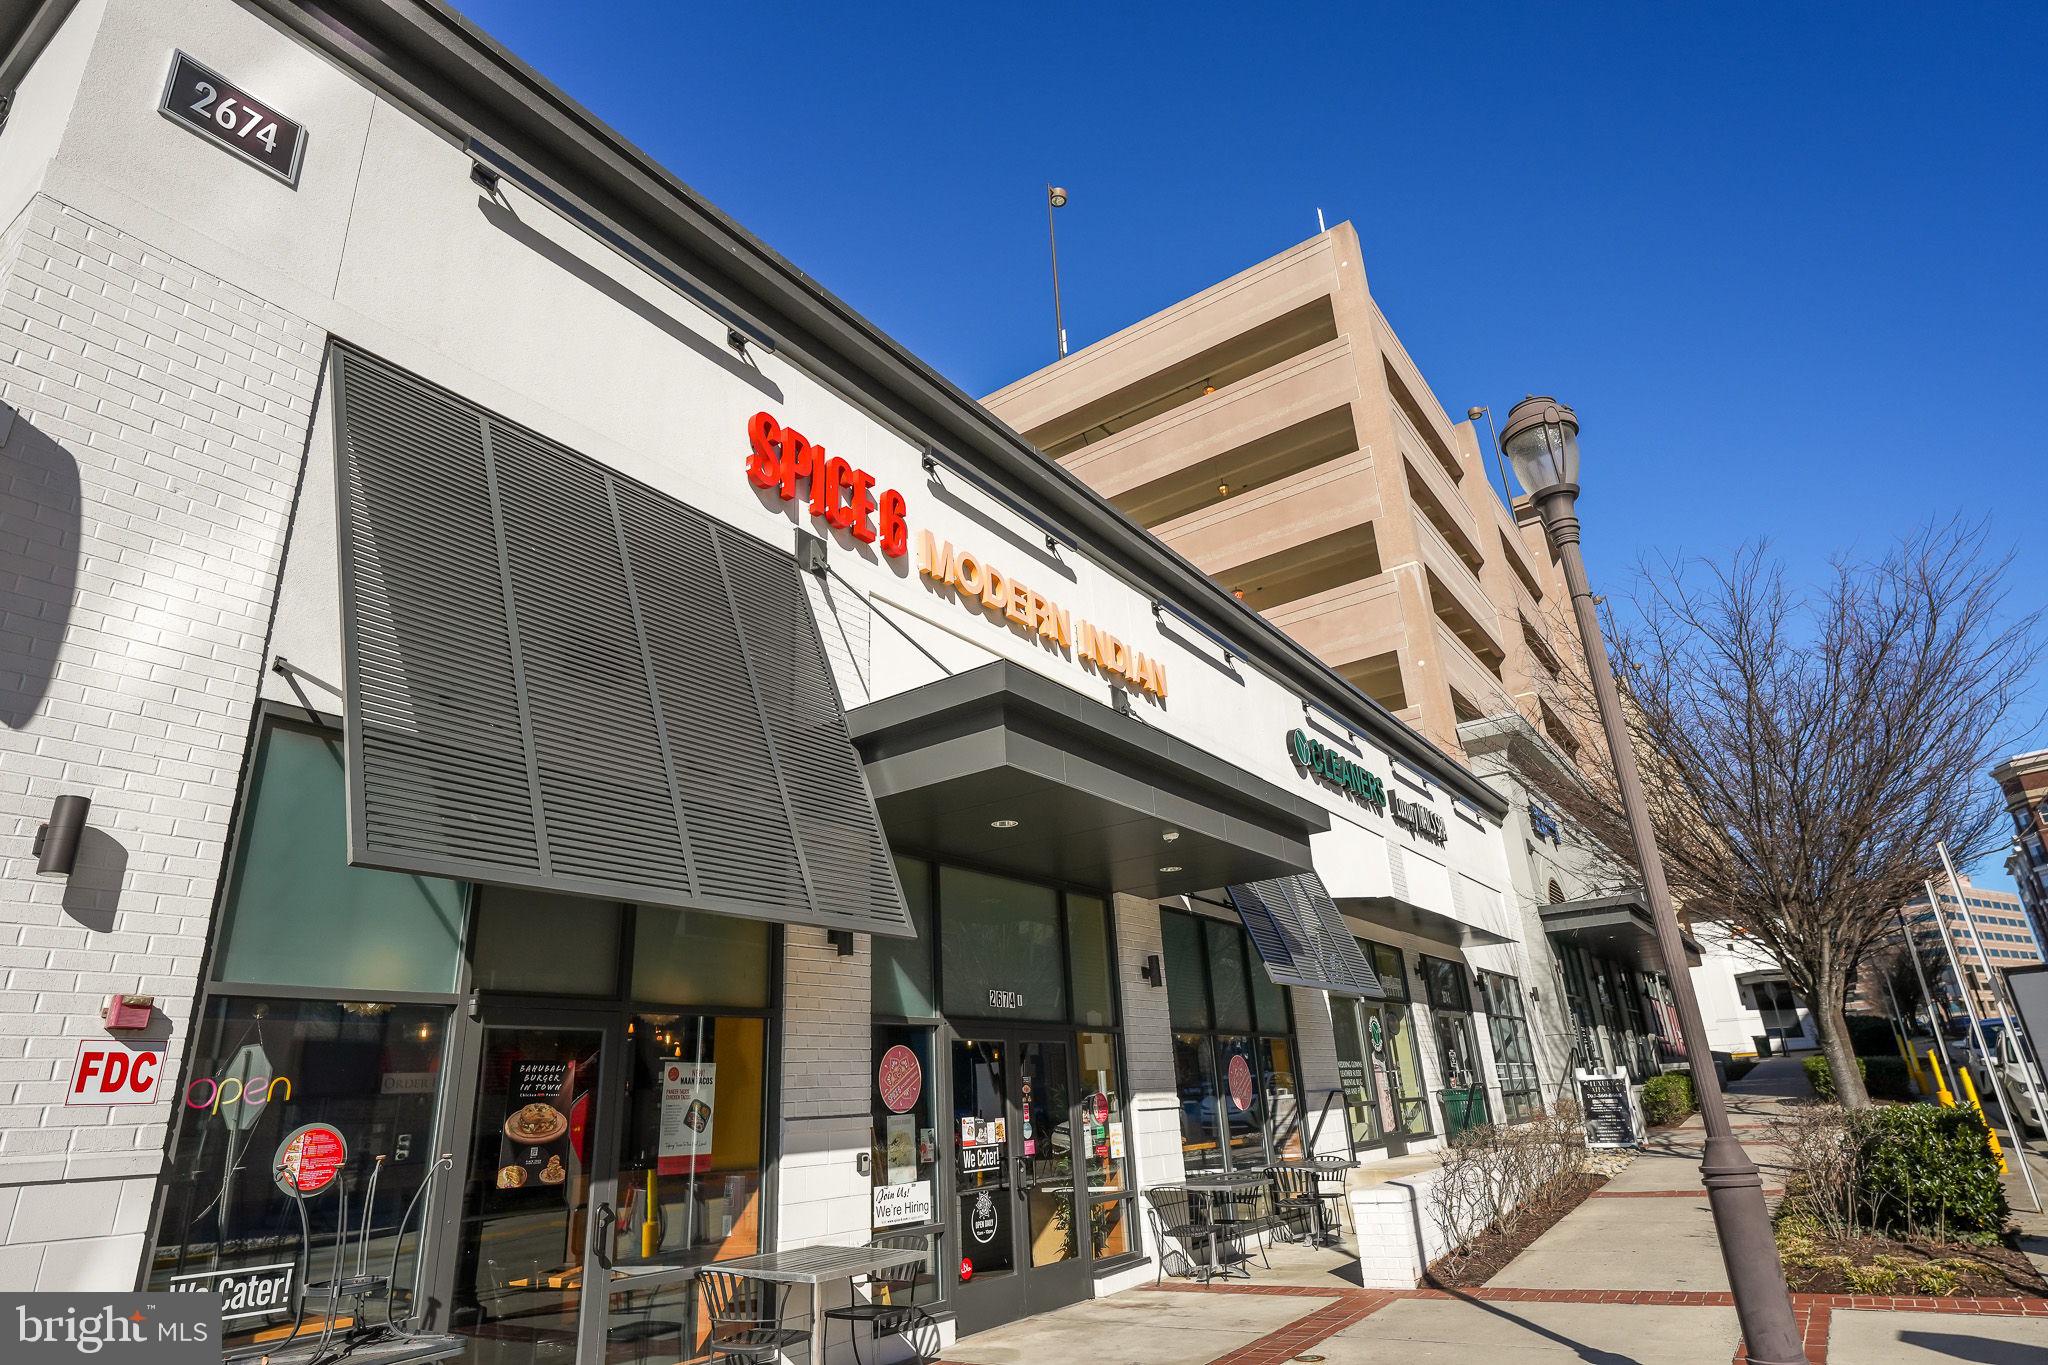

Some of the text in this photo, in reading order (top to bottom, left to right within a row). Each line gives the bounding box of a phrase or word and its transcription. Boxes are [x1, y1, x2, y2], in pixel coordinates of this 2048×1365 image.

[190, 81, 277, 154] 2674
[745, 411, 908, 558] SPICE 6
[918, 528, 1168, 698] MODERN INDIAN
[1309, 738, 1387, 808] CLEANERS
[990, 990, 1015, 1008] 2674
[76, 1051, 157, 1093] FDC
[519, 1064, 566, 1072] BAHUBALI
[519, 1083, 562, 1091] IN TOWN
[524, 1074, 560, 1083] BURGER
[680, 1077, 695, 1085] NAAN
[186, 1075, 292, 1115] open
[963, 1147, 1000, 1168] We Cater!
[875, 1186, 911, 1203] Join Us!
[875, 1204, 902, 1218] We're
[904, 1201, 930, 1214] Hiring
[975, 1220, 984, 1229] OPEN
[219, 1268, 294, 1311] Cater!
